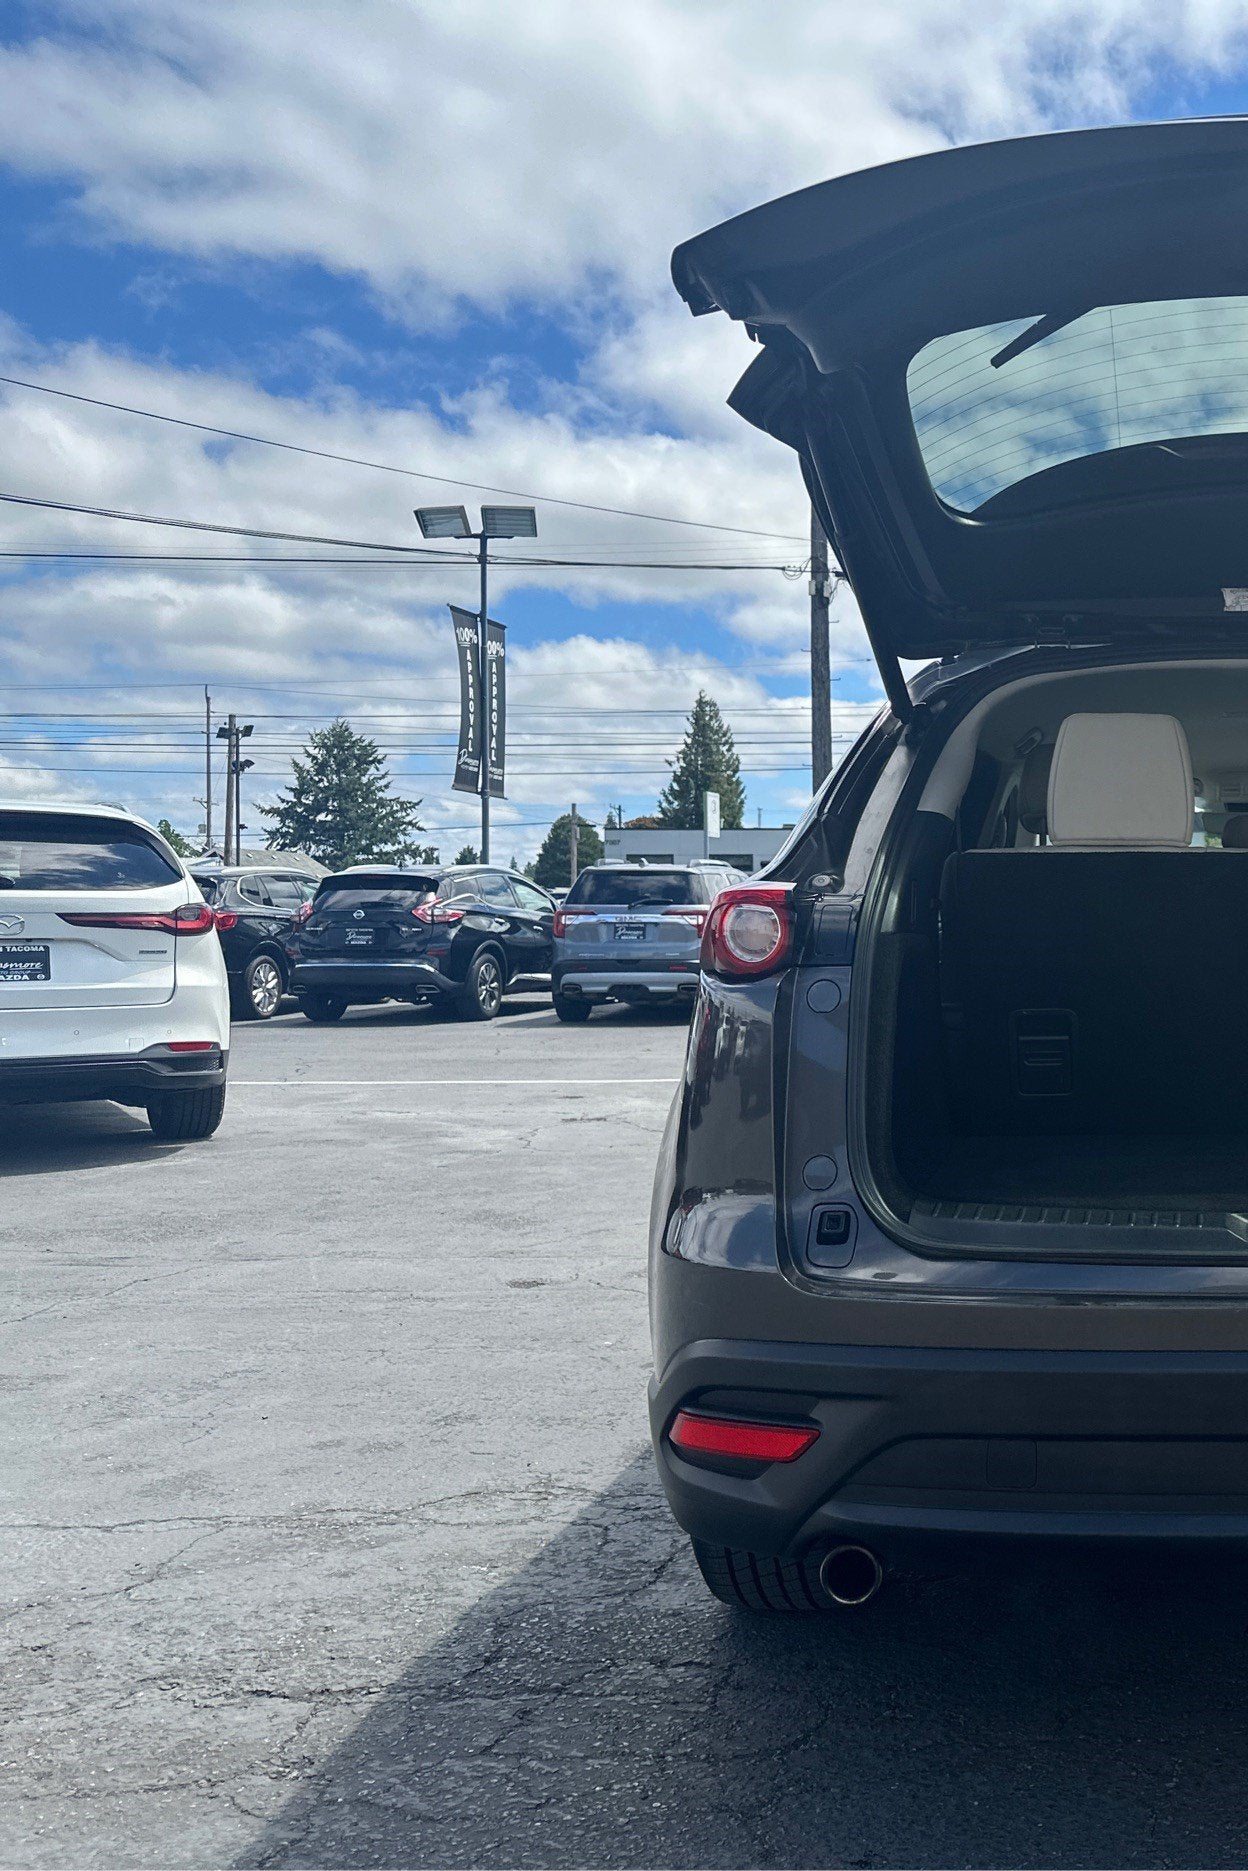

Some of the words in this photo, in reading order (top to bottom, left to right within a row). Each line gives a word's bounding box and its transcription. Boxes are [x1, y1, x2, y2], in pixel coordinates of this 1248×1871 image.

[456, 627, 478, 644] 100%
[487, 640, 505, 658] 00%
[466, 649, 475, 752] APPROVAL
